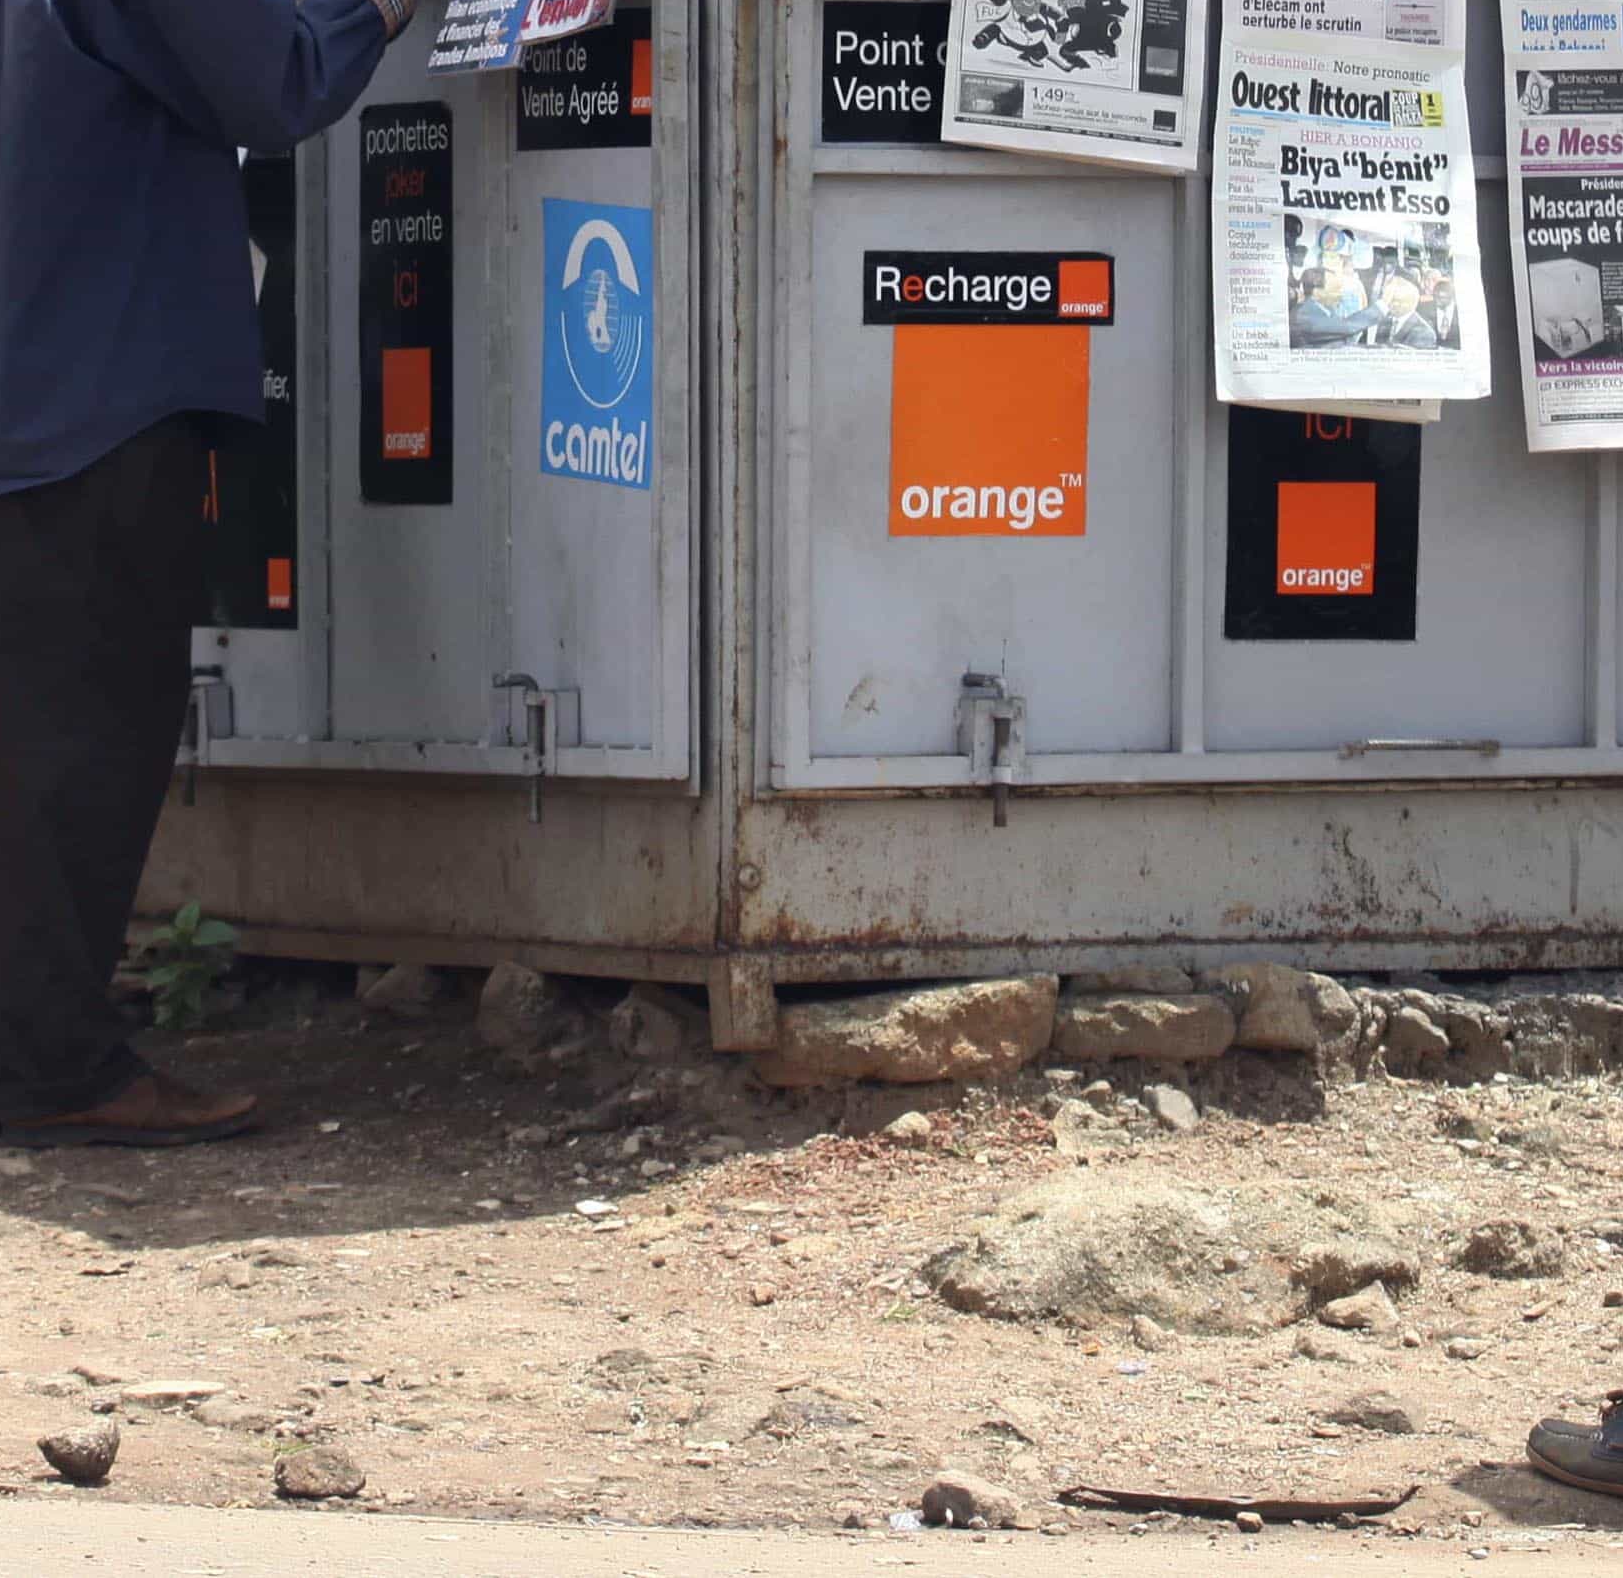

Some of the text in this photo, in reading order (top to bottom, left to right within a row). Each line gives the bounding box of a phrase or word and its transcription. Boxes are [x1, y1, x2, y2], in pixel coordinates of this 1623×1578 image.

[1304, 0, 1325, 14] ont
[1300, 16, 1362, 32] le scrutin
[1521, 9, 1617, 39] Deux gendarmes
[567, 45, 586, 70] de
[835, 30, 924, 67] Point
[1333, 61, 1369, 77] Notre
[523, 83, 619, 122] Vente Agréé
[832, 77, 932, 112] Vente
[1232, 71, 1391, 122] Ouest littoral
[367, 120, 448, 163] pochettes
[1350, 133, 1423, 149] BONANJO
[1520, 127, 1550, 156] Le
[1280, 145, 1340, 185] Biya
[1280, 180, 1450, 216] Laurent Esso
[371, 213, 442, 245] en vente
[1528, 225, 1582, 251] coups
[1589, 223, 1610, 244] de
[394, 260, 418, 308] ici
[876, 266, 1051, 311] Recharge
[1061, 300, 1104, 318] orange
[1539, 362, 1568, 373] Vers
[385, 431, 425, 455] orange
[545, 420, 647, 485] camtel
[900, 482, 1064, 530] orange
[1282, 563, 1363, 591] orange
